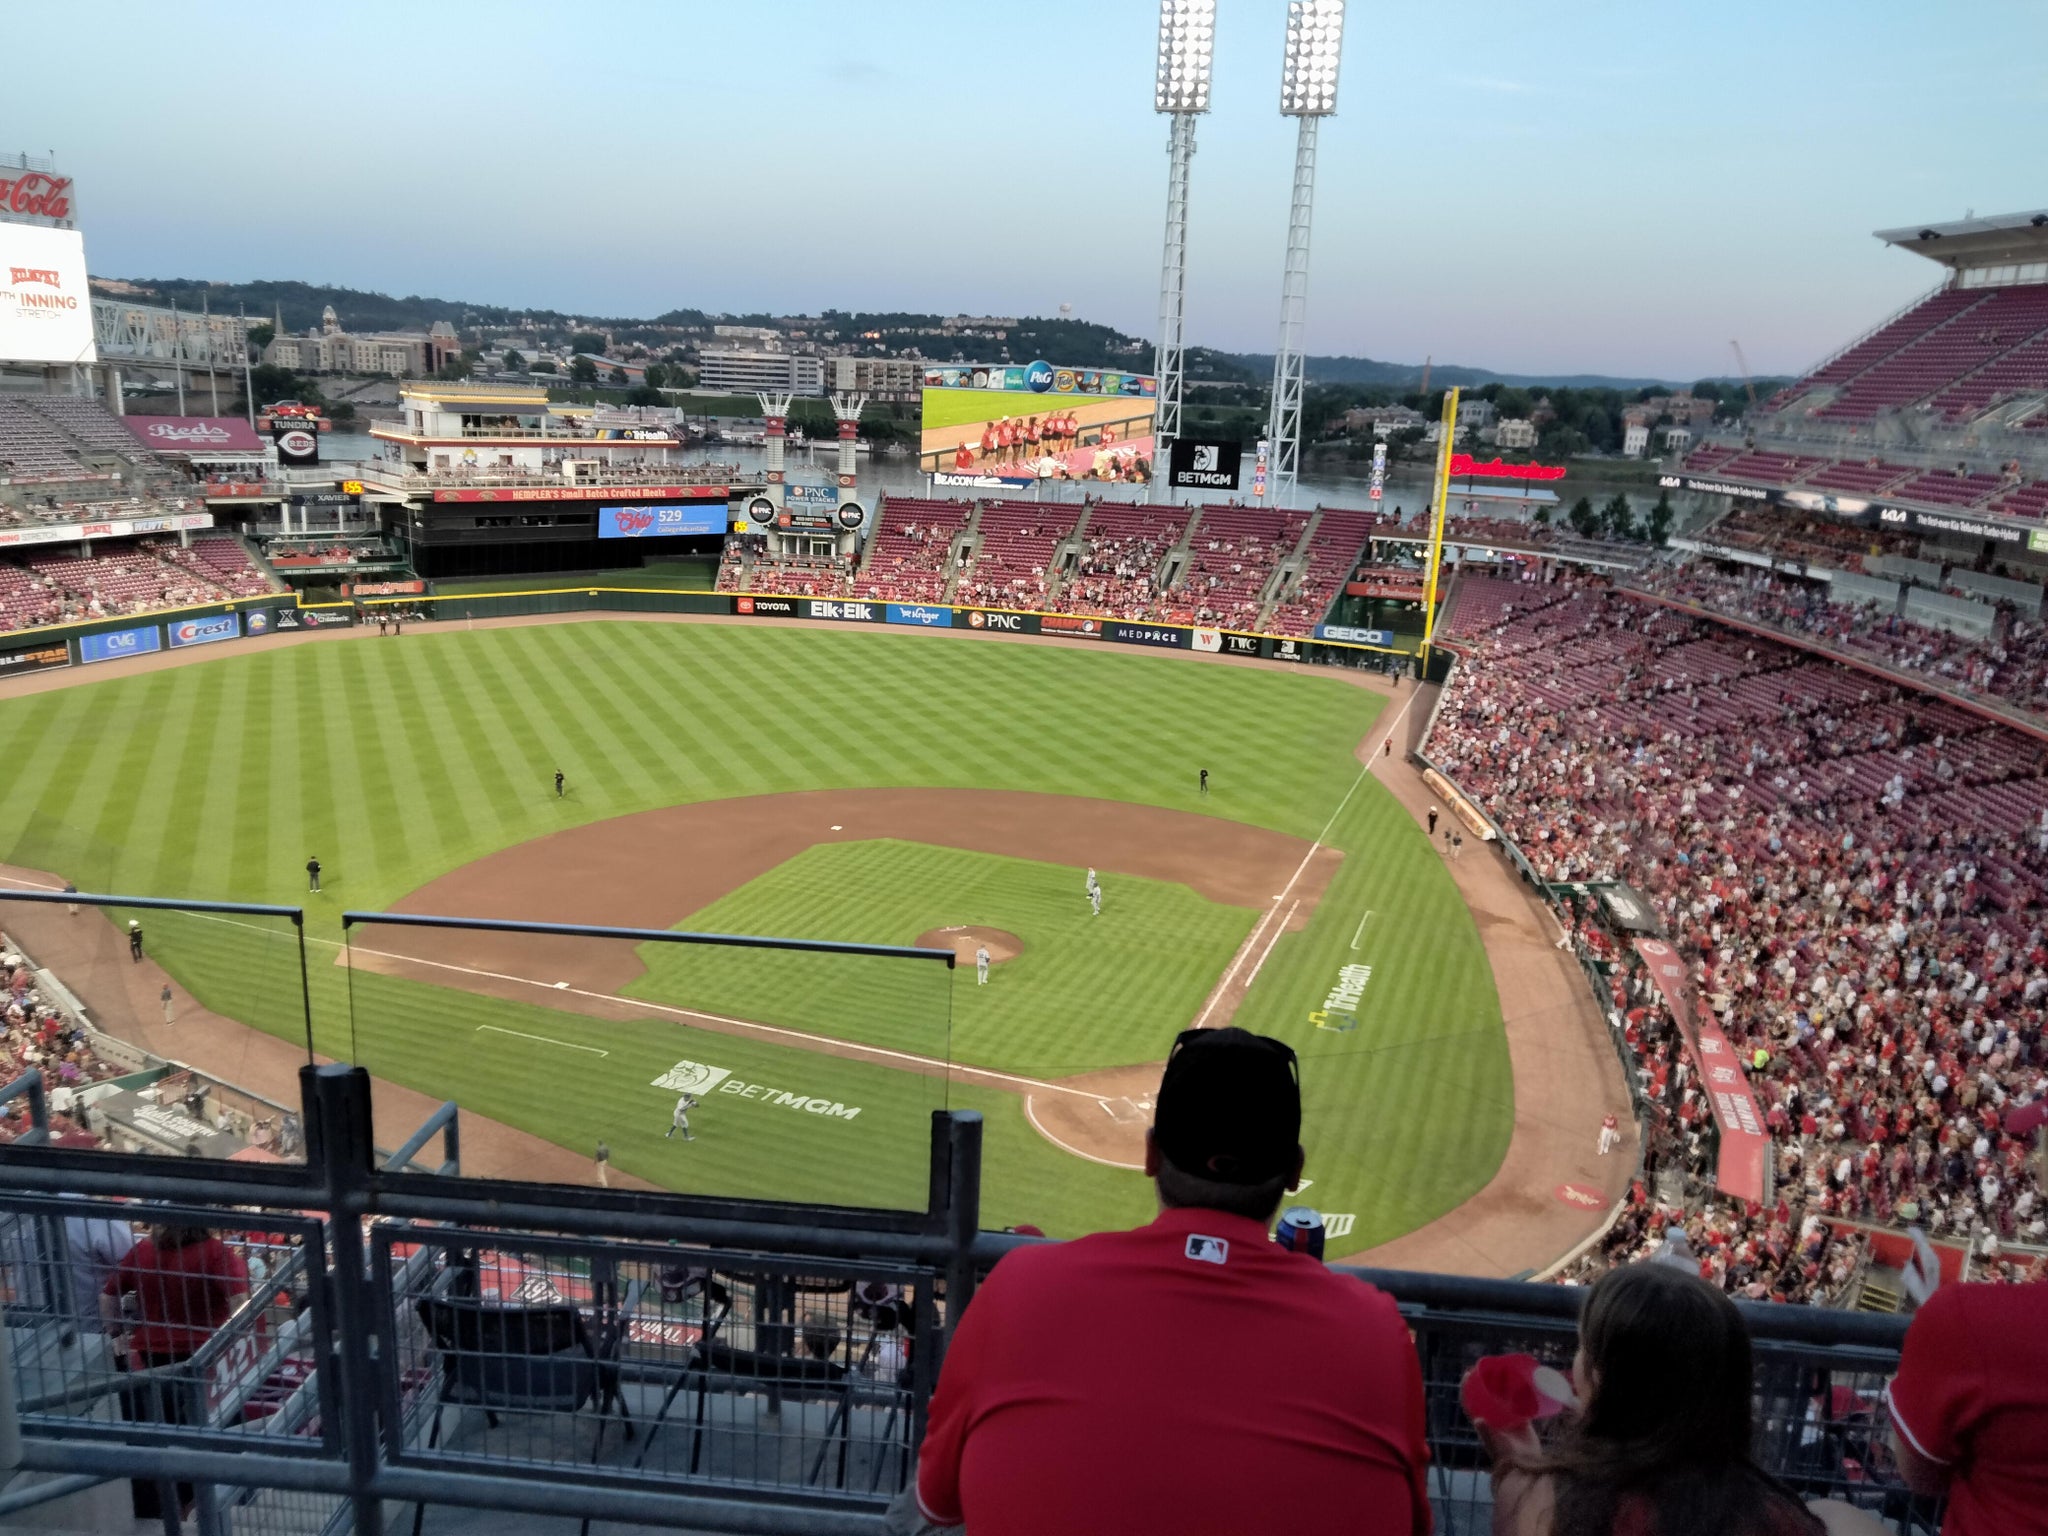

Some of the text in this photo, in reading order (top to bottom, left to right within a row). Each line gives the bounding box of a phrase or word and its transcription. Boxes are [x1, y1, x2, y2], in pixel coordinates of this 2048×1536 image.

[20, 292, 78, 310] INNING
[1030, 371, 1052, 383] P&G
[147, 422, 232, 440] Reds
[273, 420, 316, 430] TUNDRA
[632, 430, 669, 440] TriHealth
[289, 440, 316, 448] REDS
[933, 472, 973, 487] BEACON
[1177, 471, 1232, 486] BETMGM
[318, 494, 350, 502] XAVIER
[512, 488, 666, 500] HEMPLER'S Small Batch Crafted Meats
[805, 487, 829, 497] PNC
[658, 510, 682, 522] 529
[847, 512, 861, 520] PNC
[755, 601, 791, 611] TOYOTA
[912, 607, 940, 623] Kroger
[987, 613, 1021, 630] PNC
[178, 618, 232, 641] Crest
[1118, 628, 1178, 643] MEDPACE
[1322, 625, 1382, 644] GEICO
[106, 632, 137, 650] CVG
[1227, 636, 1257, 651] TWC
[719, 1078, 862, 1121] BETMGM
[210, 1329, 258, 1399] 421
